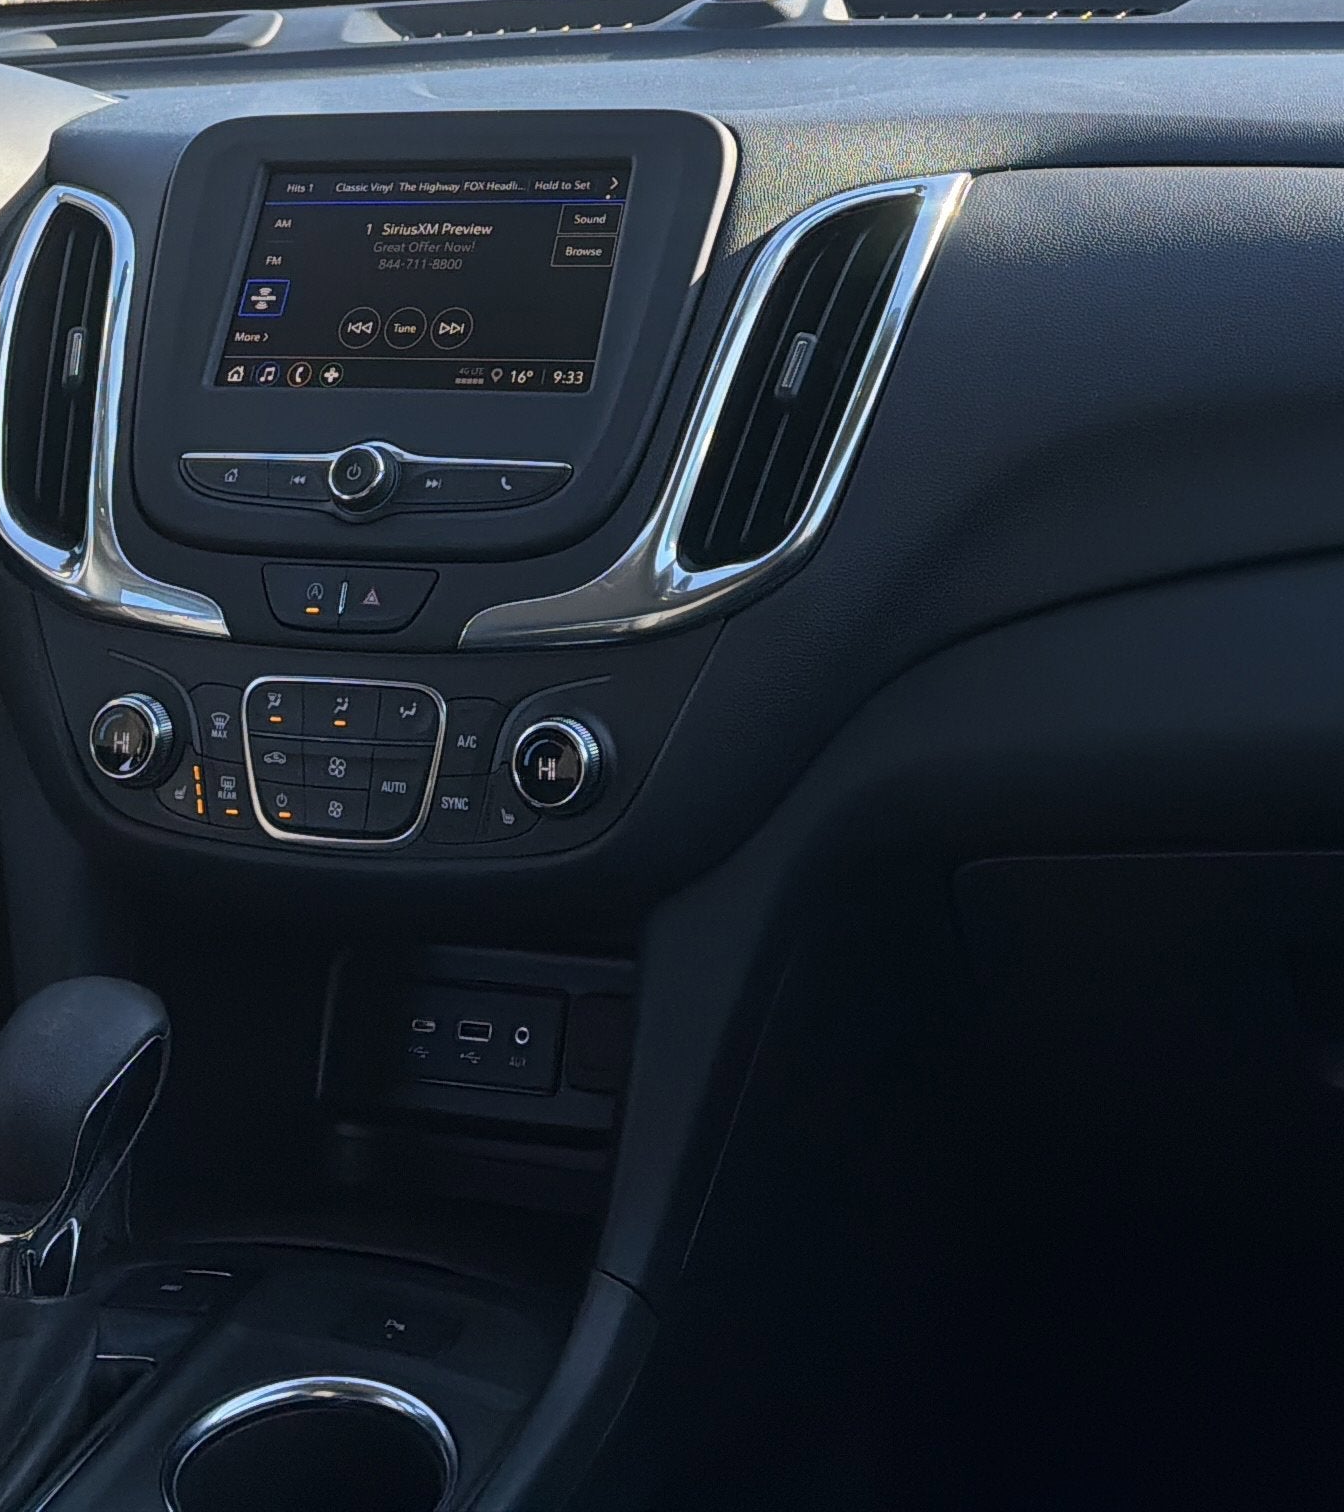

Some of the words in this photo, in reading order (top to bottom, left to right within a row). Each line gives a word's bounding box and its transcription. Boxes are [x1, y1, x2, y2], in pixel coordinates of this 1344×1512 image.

[287, 184, 305, 193] Hits
[336, 182, 368, 192] Classic
[370, 182, 393, 194] Vinyl
[399, 182, 417, 192] The
[419, 182, 460, 194] Highway
[463, 181, 485, 191] FOX
[535, 181, 559, 190] Hold
[561, 181, 571, 190] to
[574, 181, 591, 190] Set
[274, 219, 292, 229] AM
[574, 214, 606, 224] Sound
[365, 223, 372, 236] 1
[382, 223, 439, 236] SiriusXM
[441, 223, 493, 235] Preview
[373, 241, 406, 253] Great
[408, 240, 441, 253] Offer
[444, 240, 476, 253] Now!
[565, 246, 603, 257] Browse
[265, 255, 282, 265] FM
[378, 258, 463, 270] 844-711-8800
[393, 323, 417, 335] Tune
[234, 332, 260, 342] More
[510, 370, 534, 384] 16°
[553, 370, 584, 384] 9:33
[211, 729, 228, 739] MAX
[457, 735, 478, 749] A/C
[380, 781, 407, 795] AUTO
[217, 790, 237, 800] REAR
[441, 796, 469, 811] SYNC
